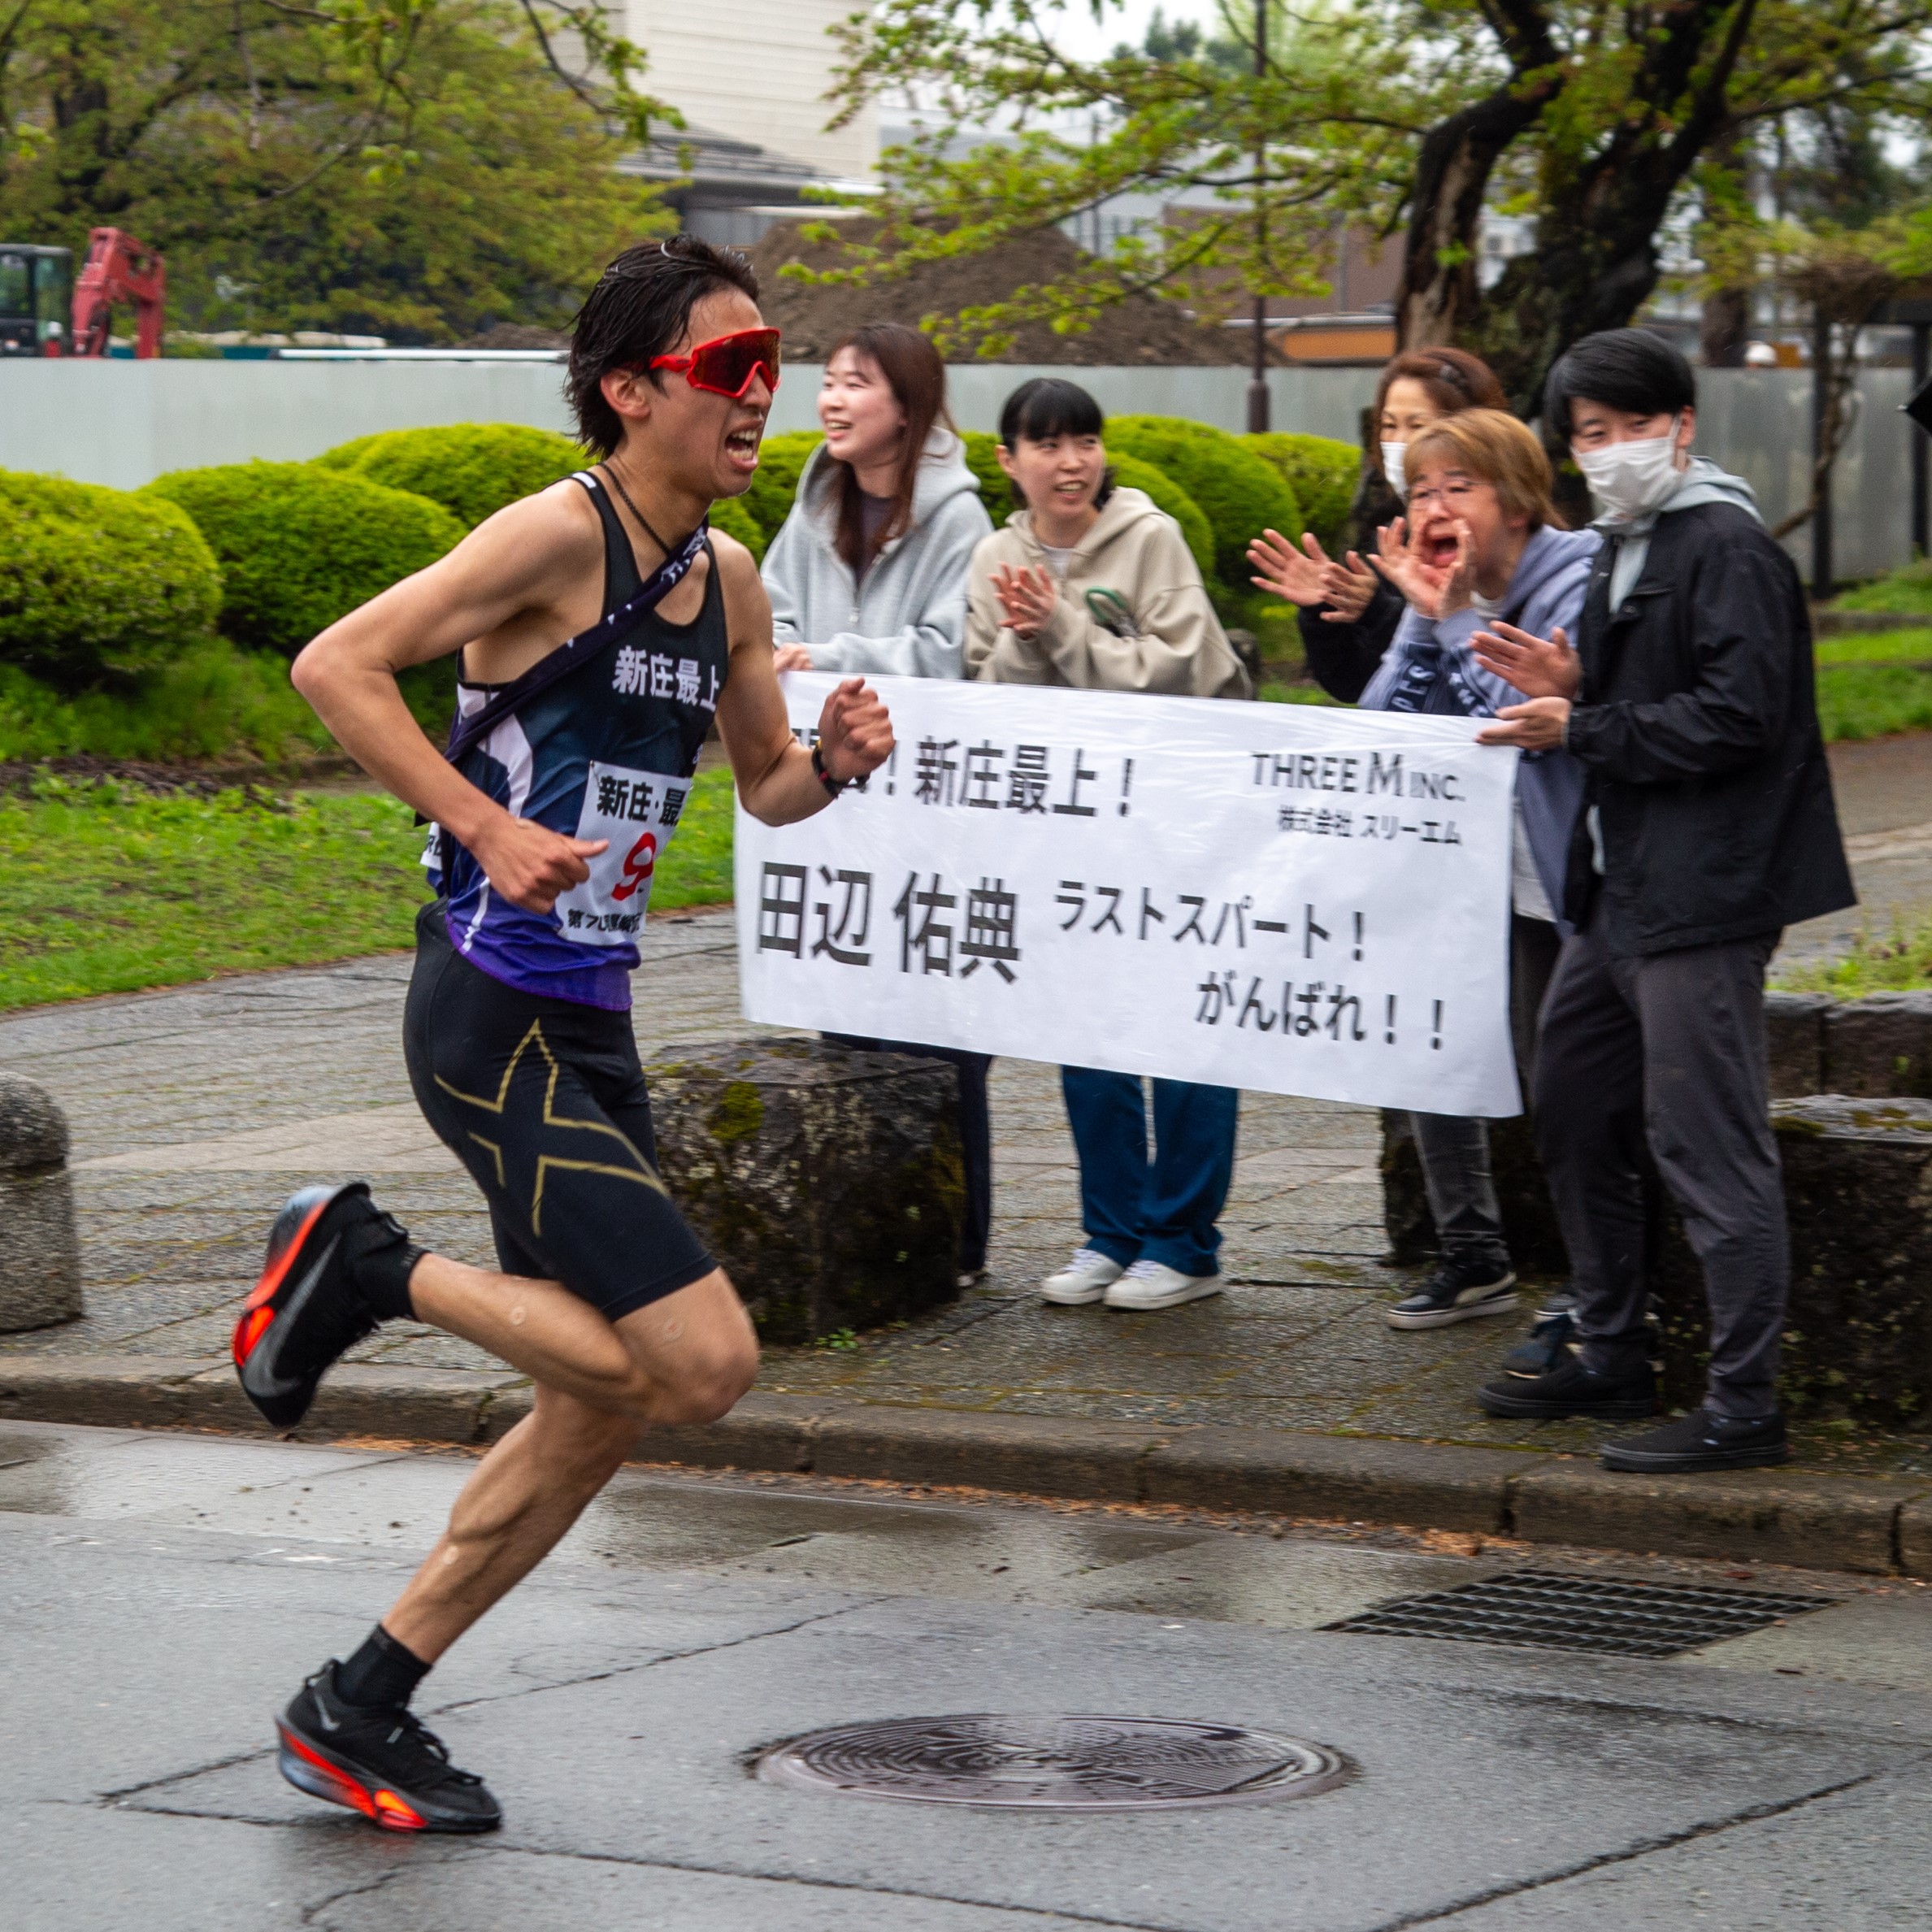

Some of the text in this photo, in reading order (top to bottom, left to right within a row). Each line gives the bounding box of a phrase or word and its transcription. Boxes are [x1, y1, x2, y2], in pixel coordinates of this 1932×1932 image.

[612, 645, 720, 713] 新庄最上
[1251, 751, 1466, 802] THREE M INC.
[1277, 804, 1463, 847] 株式会社 スリーエム
[611, 831, 658, 901] 9
[756, 861, 1367, 984] 田辺 佑典 ラストスパート！
[1195, 970, 1445, 1051] がんばれ！！
